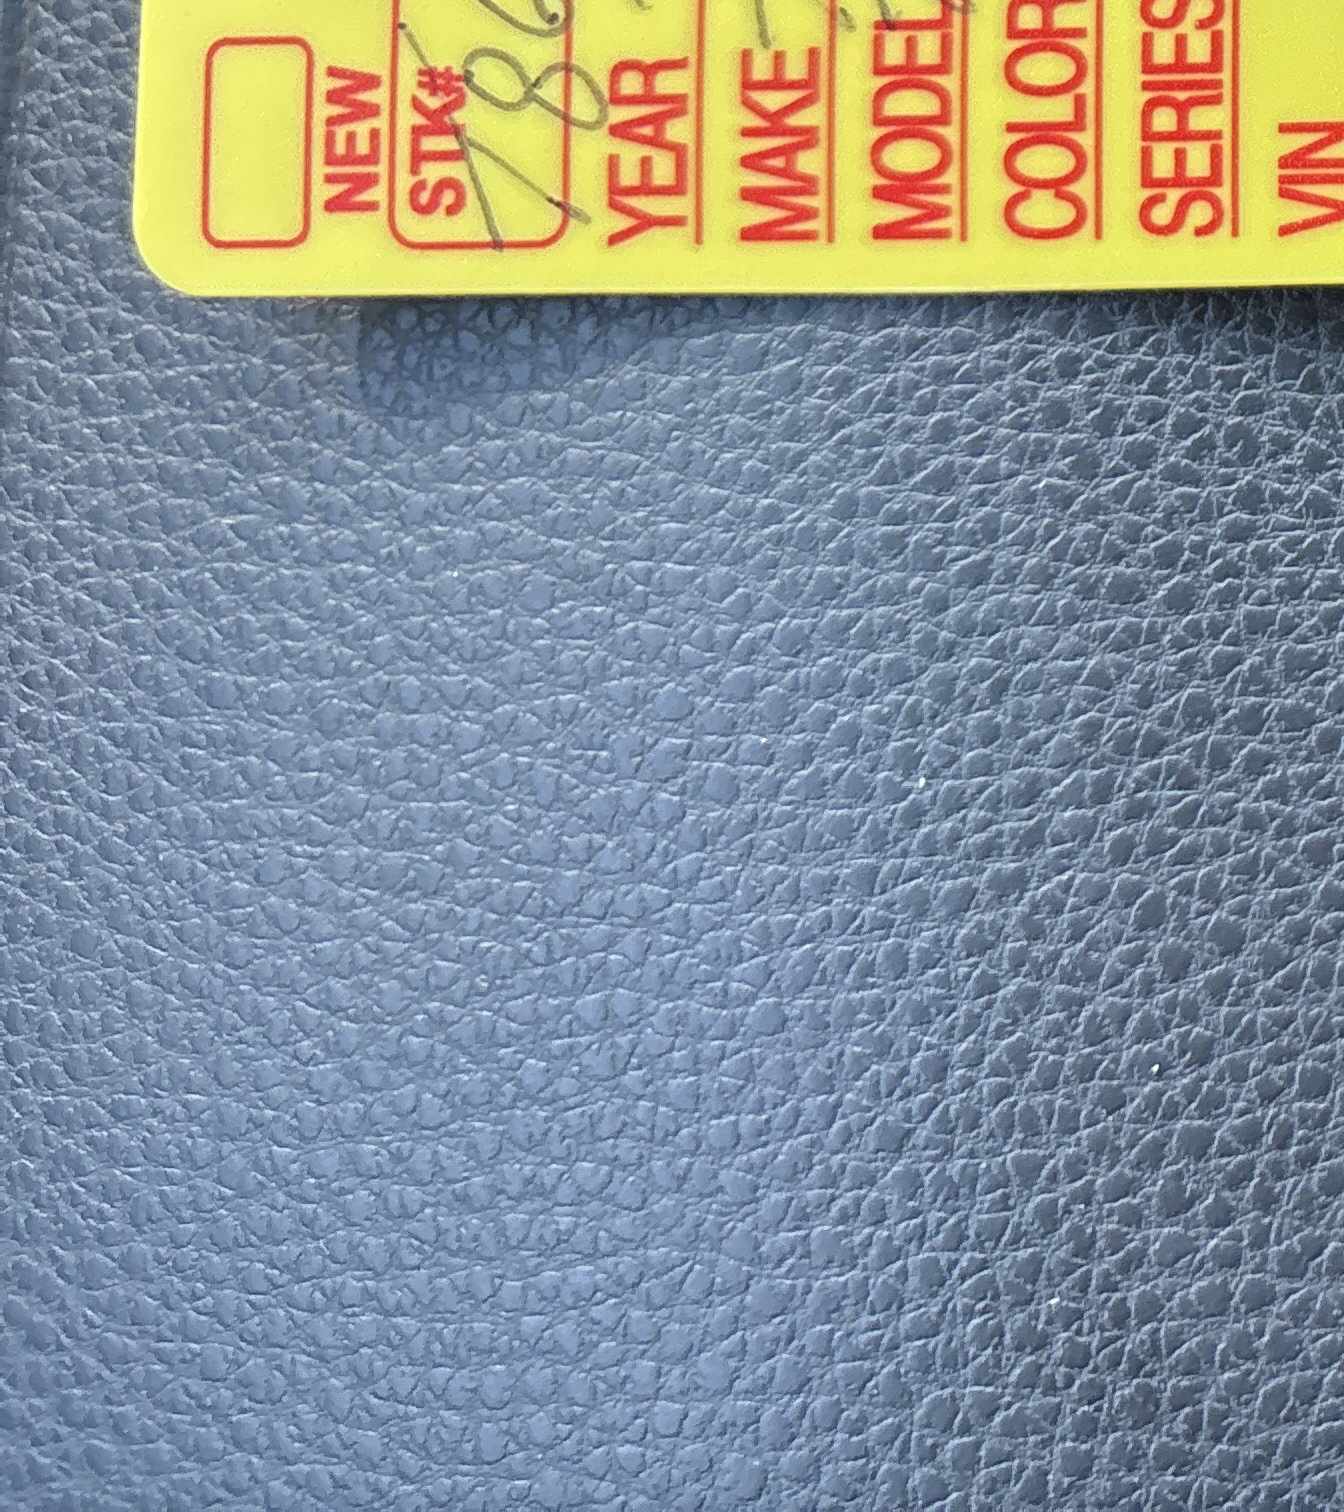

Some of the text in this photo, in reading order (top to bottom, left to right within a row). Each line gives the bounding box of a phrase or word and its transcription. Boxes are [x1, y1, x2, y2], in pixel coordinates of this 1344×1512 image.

[323, 65, 383, 214] NEW
[408, 64, 467, 218] STK#
[607, 55, 689, 247] YEAR
[739, 45, 822, 243] MAKE
